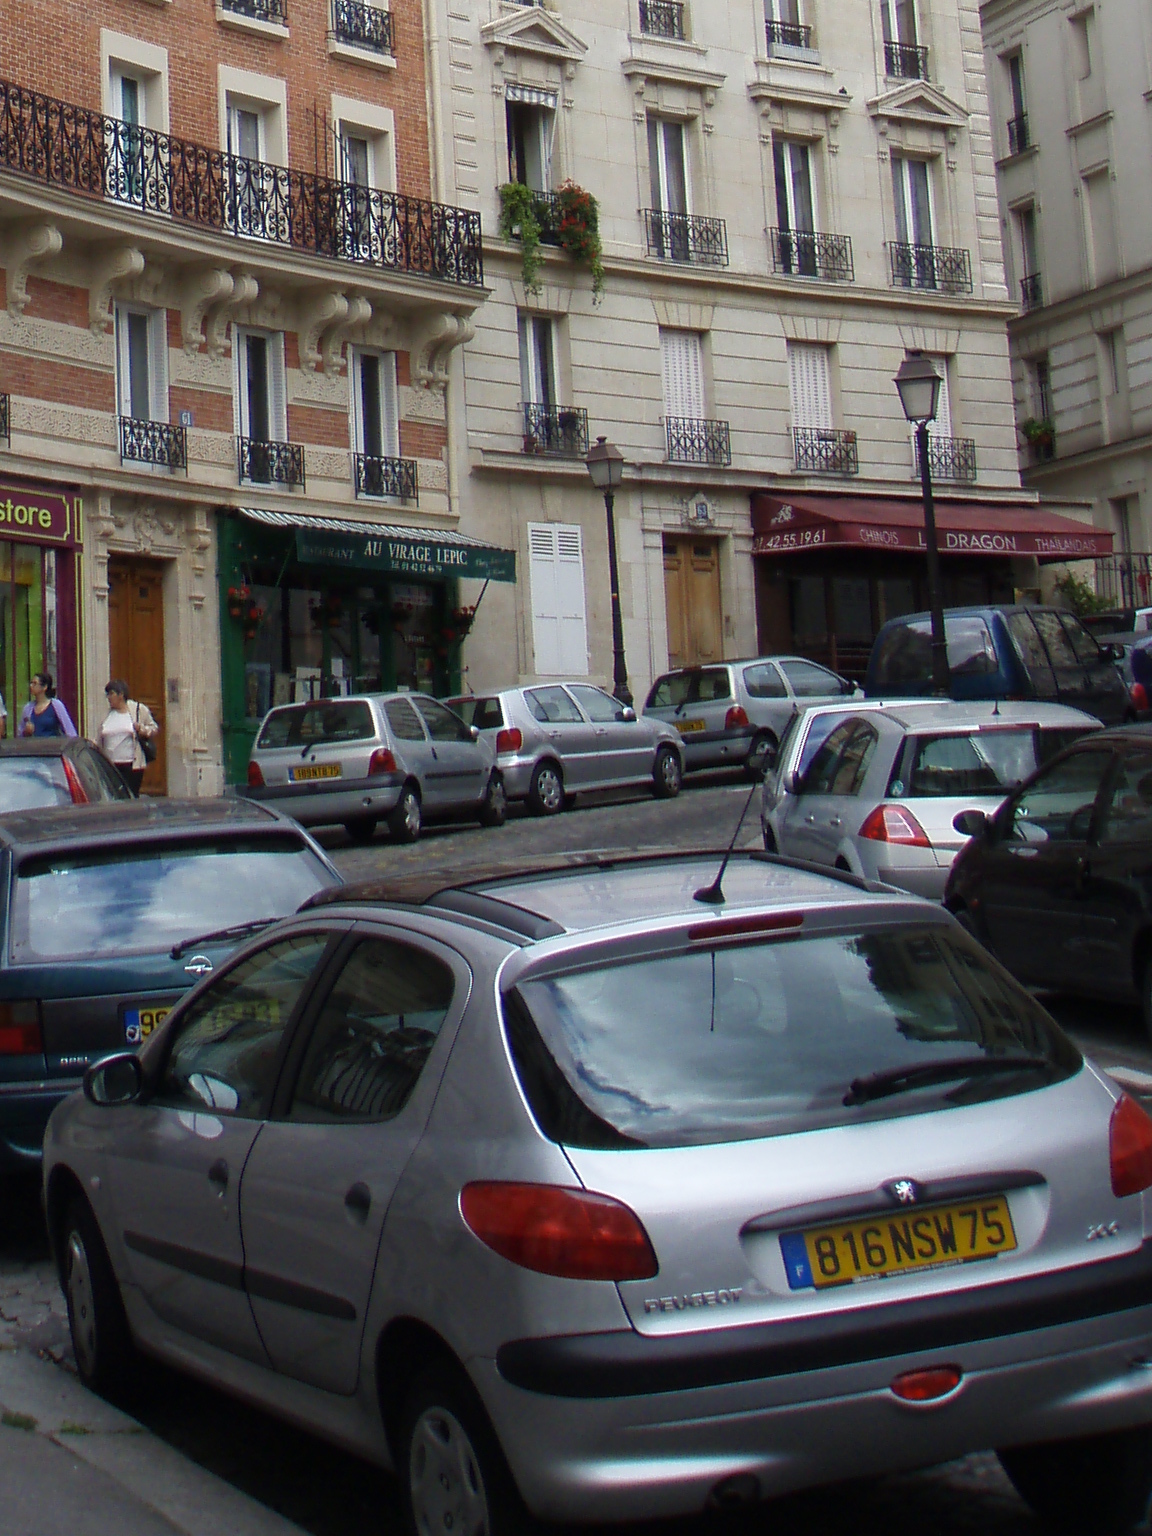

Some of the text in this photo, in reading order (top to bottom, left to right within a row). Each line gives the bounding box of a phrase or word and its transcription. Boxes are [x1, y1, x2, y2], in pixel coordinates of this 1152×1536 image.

[182, 412, 191, 425] 61
[859, 528, 899, 545] CHINOIS
[946, 533, 1017, 551] DRAGON
[364, 540, 383, 557] AU
[388, 542, 432, 562] VIRAGE
[436, 547, 468, 565] LEPIC
[795, 1264, 804, 1278] F
[644, 1287, 743, 1314] PEUGEOT
